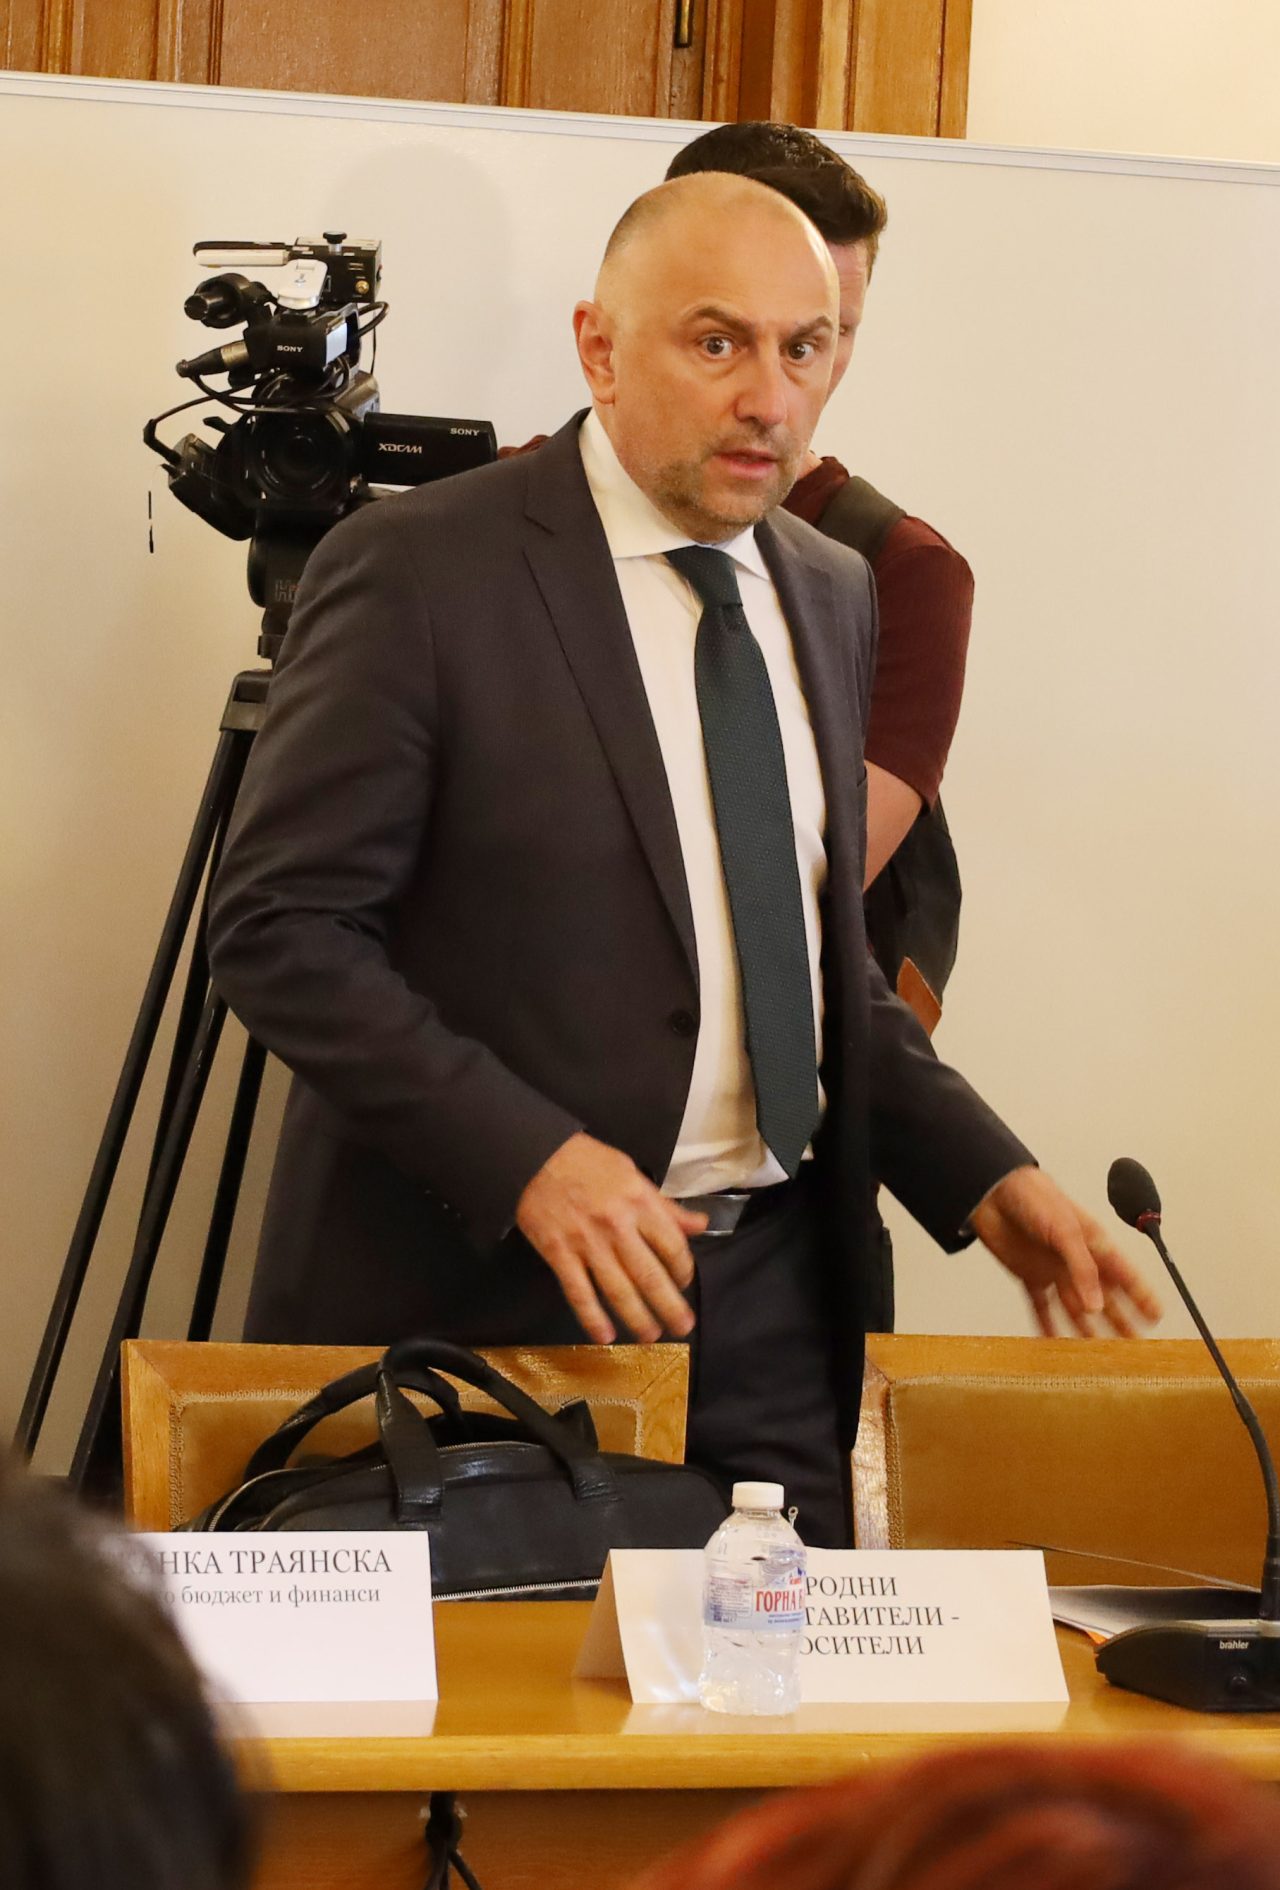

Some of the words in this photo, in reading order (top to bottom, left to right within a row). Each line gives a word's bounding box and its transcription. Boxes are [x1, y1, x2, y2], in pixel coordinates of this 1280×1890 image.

[276, 345, 303, 353] SONY
[450, 428, 480, 436] SONY
[378, 443, 423, 454] XDCAM
[229, 1549, 392, 1574] ТРАЯНСКА
[181, 1586, 264, 1606] бюджет
[268, 1589, 282, 1604] и
[288, 1585, 380, 1607] финанси
[805, 1575, 899, 1599] РОДНИ
[755, 1591, 797, 1612] ГОРНА
[804, 1606, 944, 1626] ТАВИТЕЛИ
[799, 1636, 926, 1656] ОСИТЕЛИ
